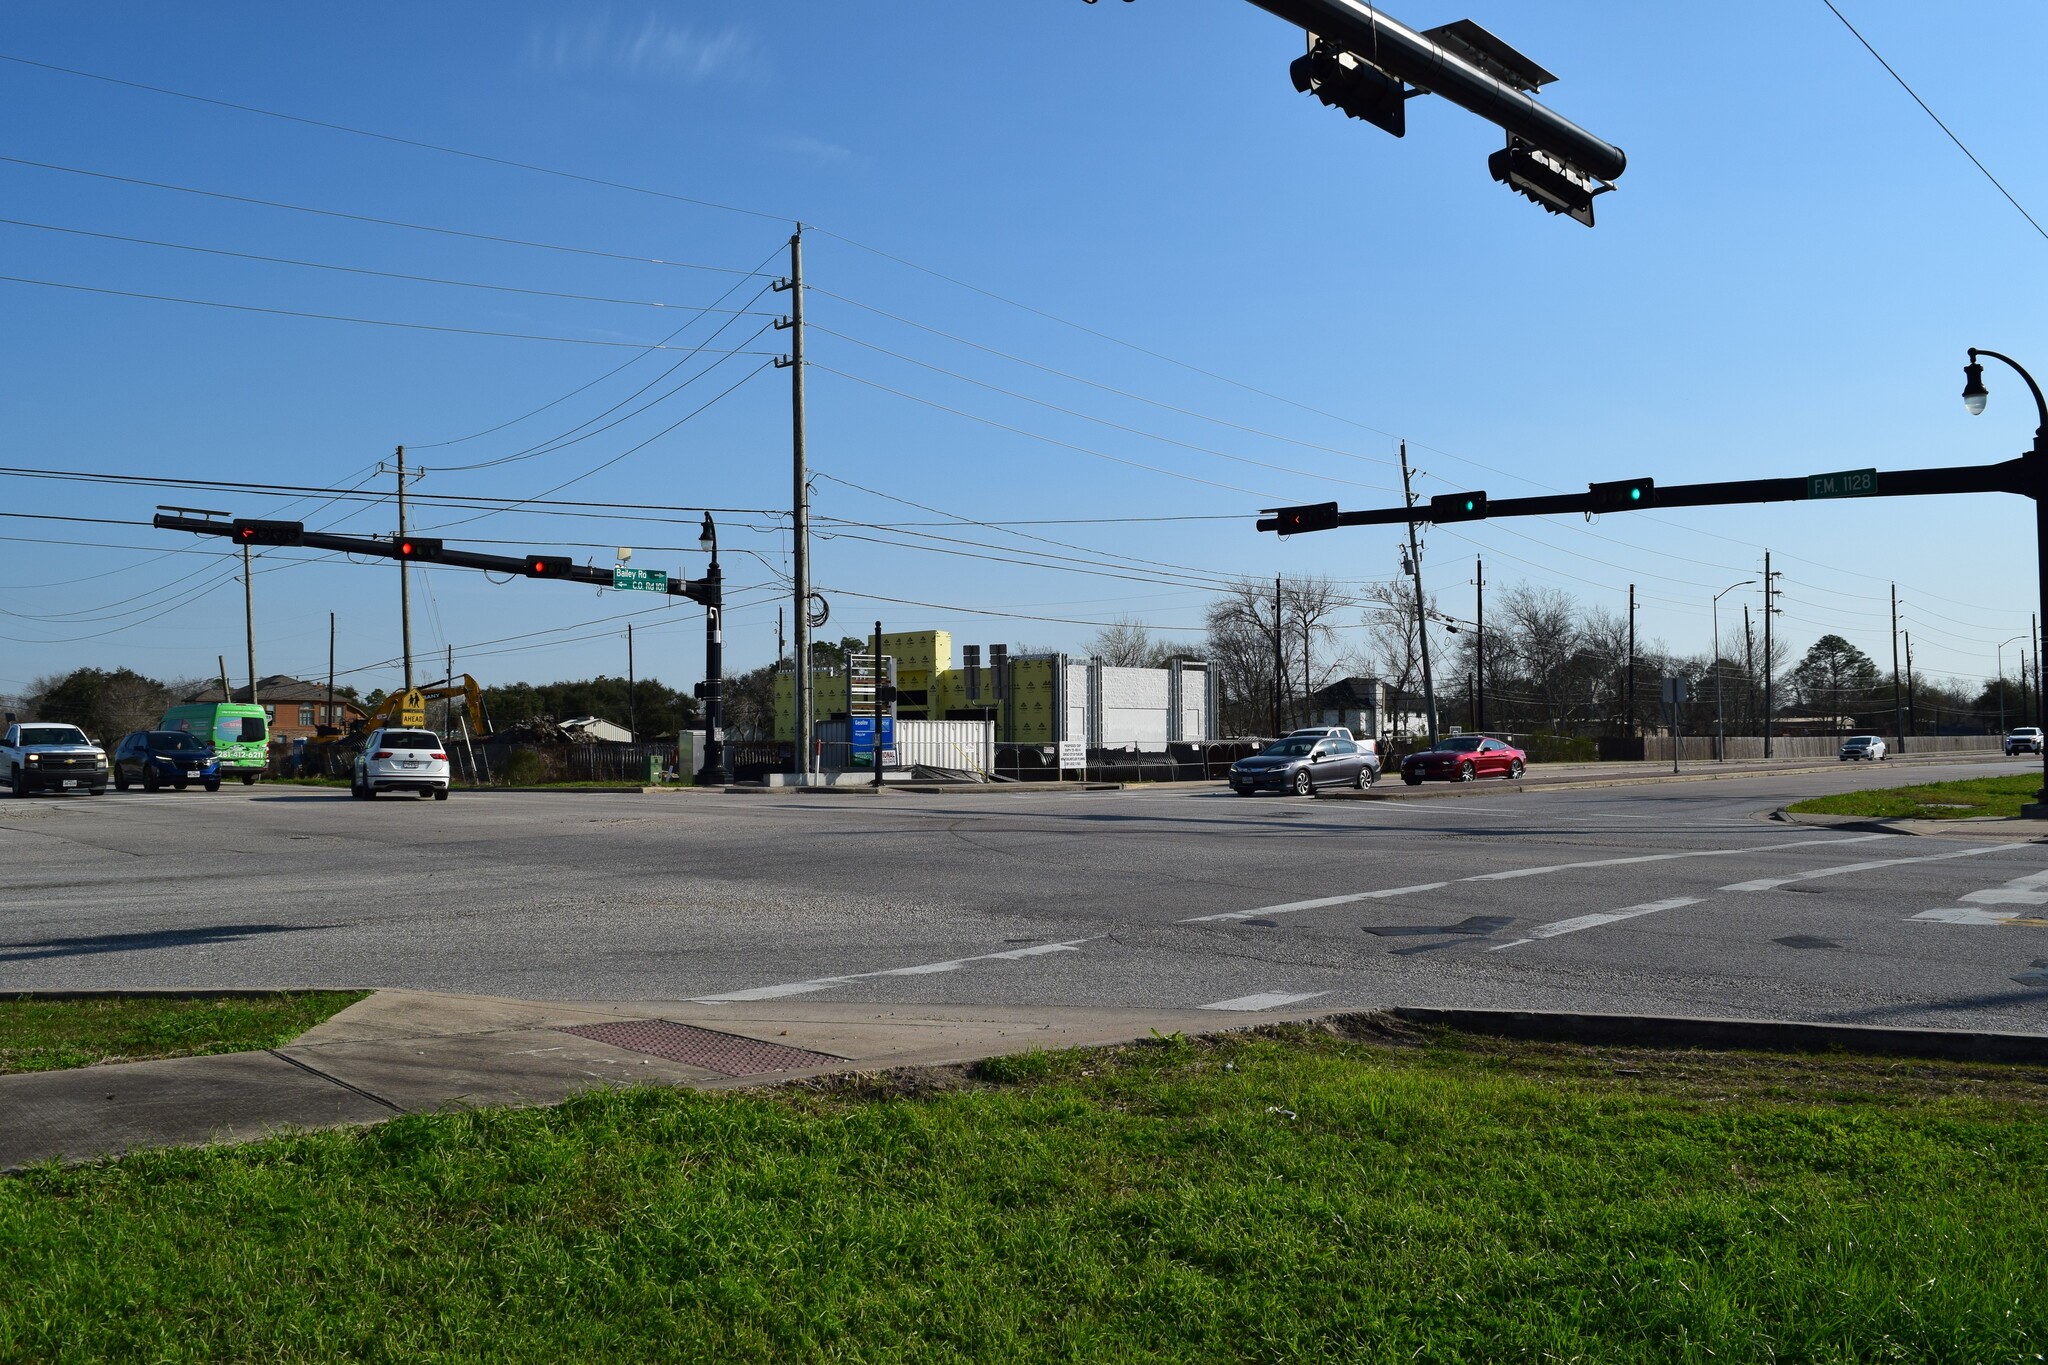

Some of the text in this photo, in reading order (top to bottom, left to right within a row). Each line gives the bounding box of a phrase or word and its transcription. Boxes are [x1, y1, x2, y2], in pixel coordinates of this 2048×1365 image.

[1814, 474, 1871, 494] F.M. 1128
[616, 568, 647, 579] Bailey Rd
[645, 582, 655, 591] Rd
[655, 582, 665, 591] 101
[404, 715, 423, 723] AHEAD
